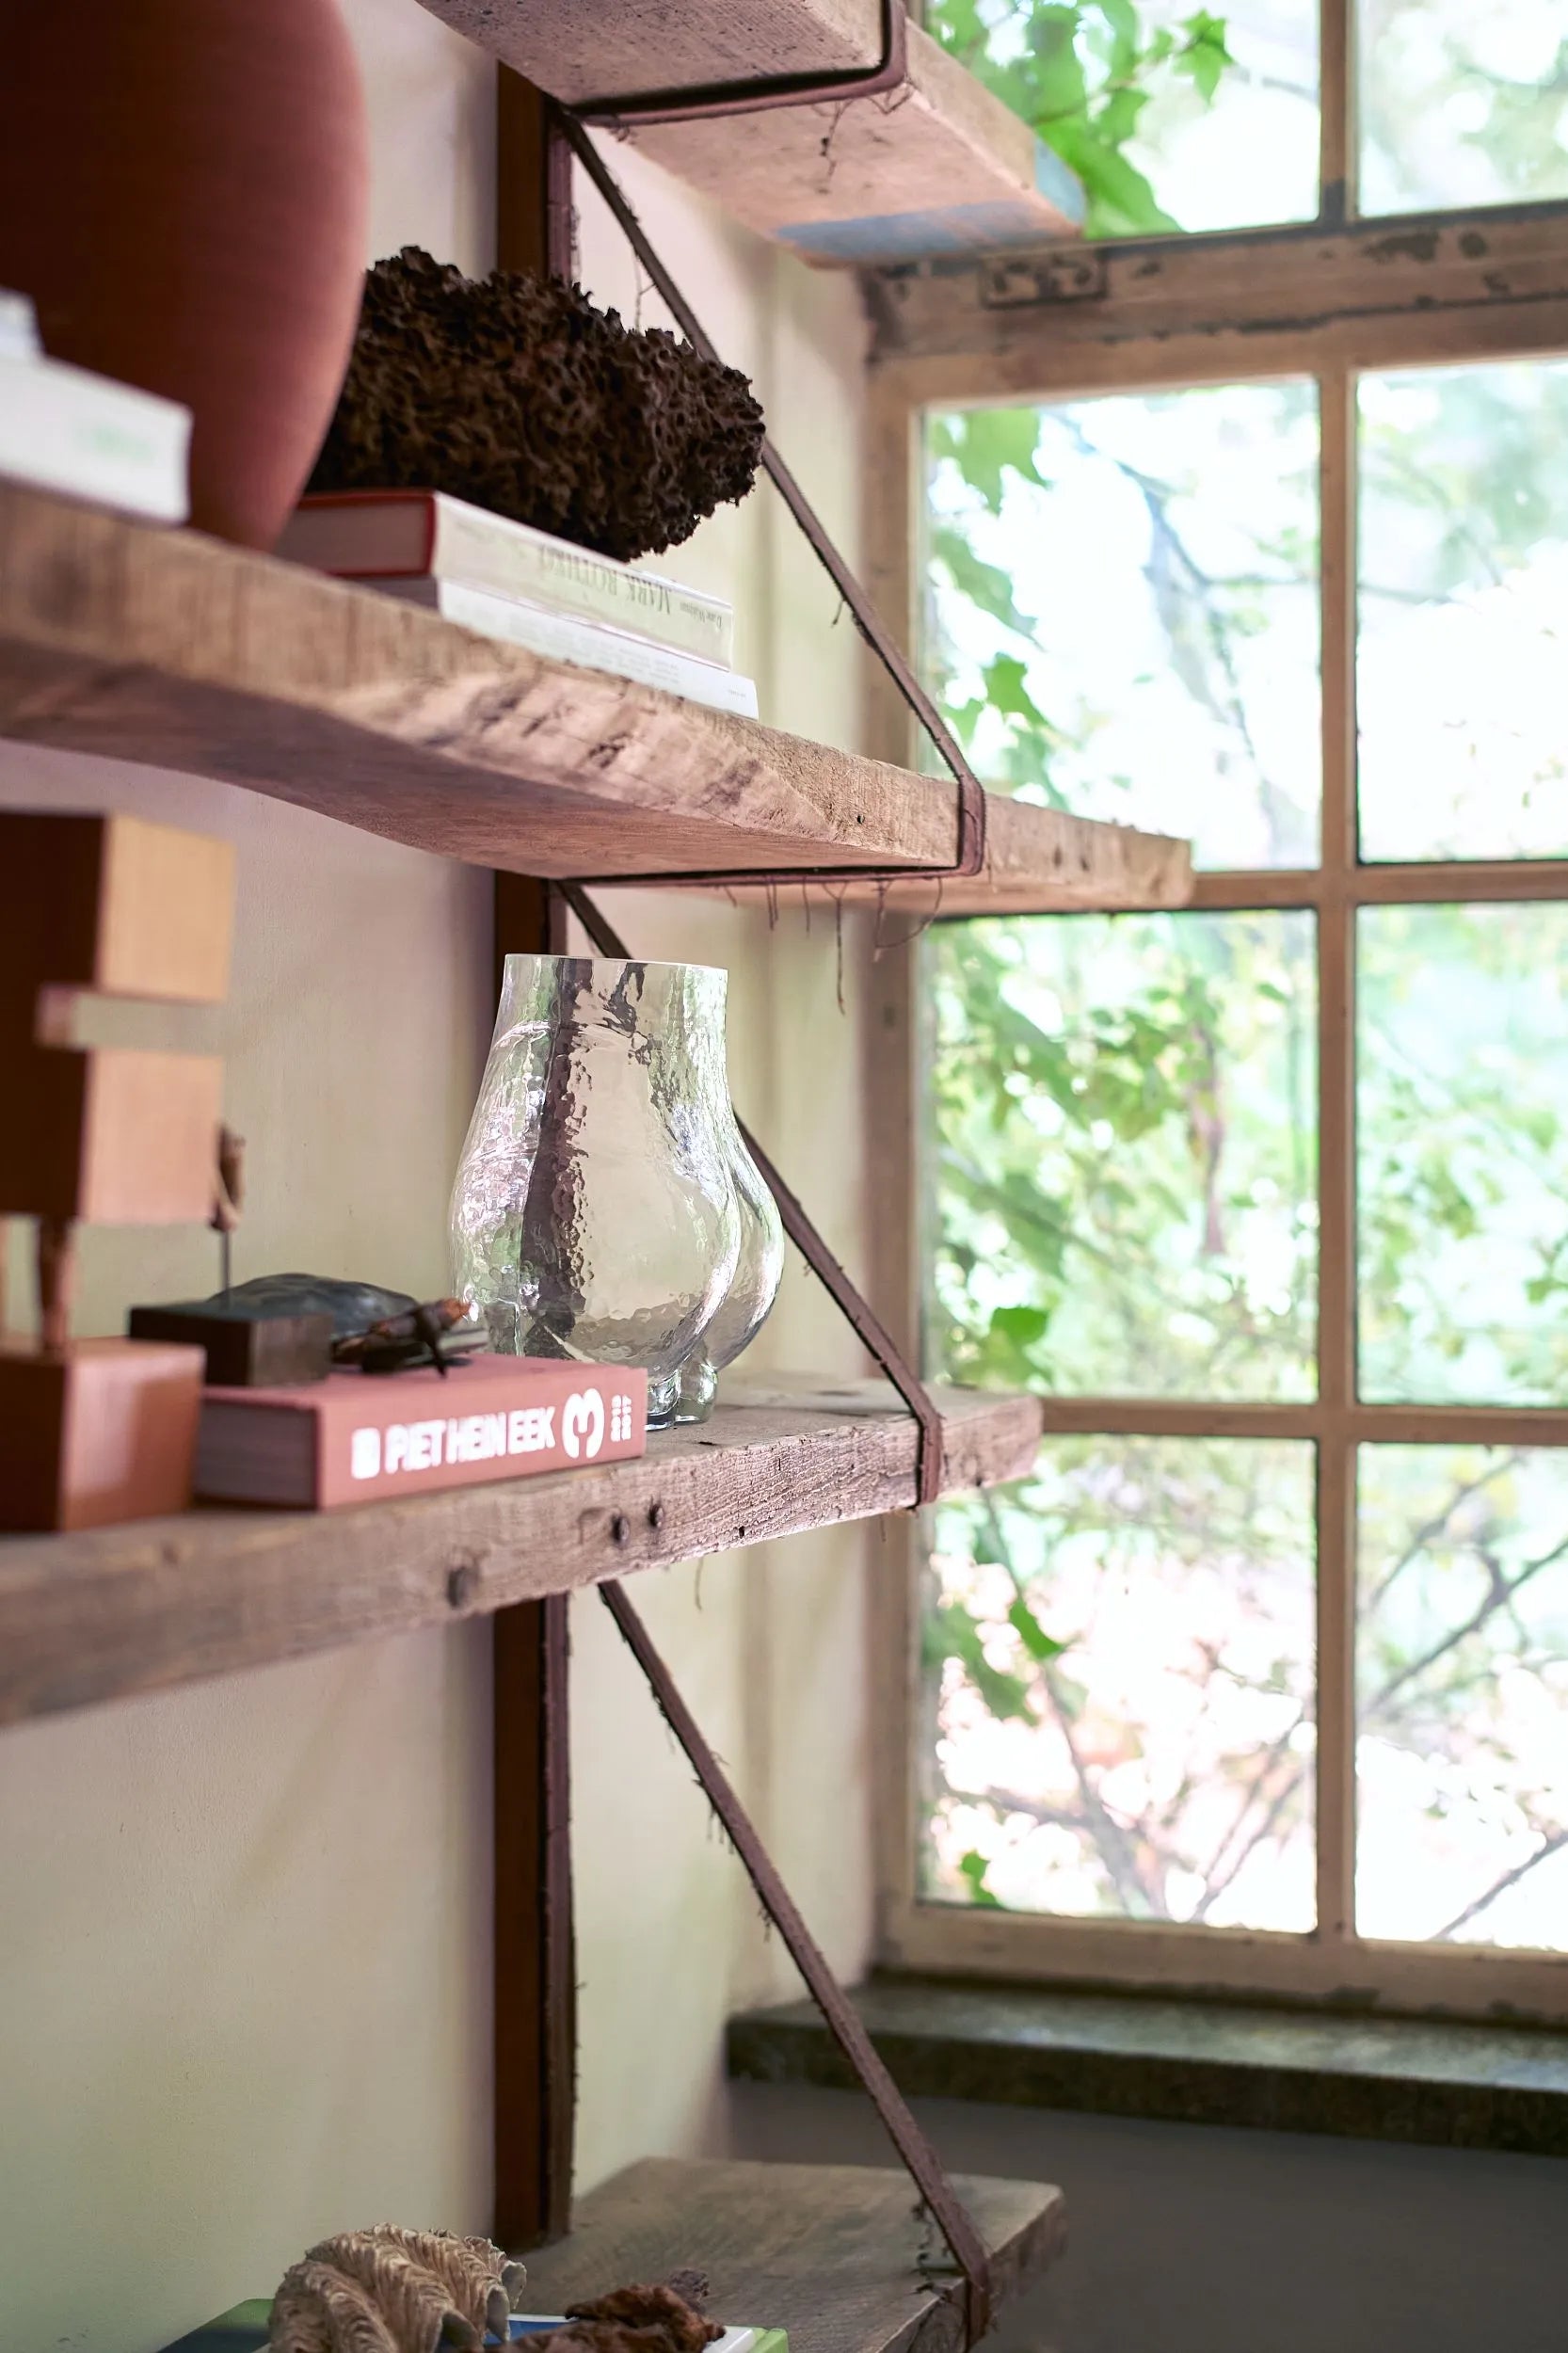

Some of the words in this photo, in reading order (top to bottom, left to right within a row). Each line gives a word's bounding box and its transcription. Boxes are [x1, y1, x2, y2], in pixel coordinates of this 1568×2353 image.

[536, 545, 618, 596] ROTHKO
[624, 573, 672, 616] MARK
[385, 1419, 446, 1475] PIET
[445, 1412, 506, 1465] HEIN
[508, 1406, 556, 1455] EEK
